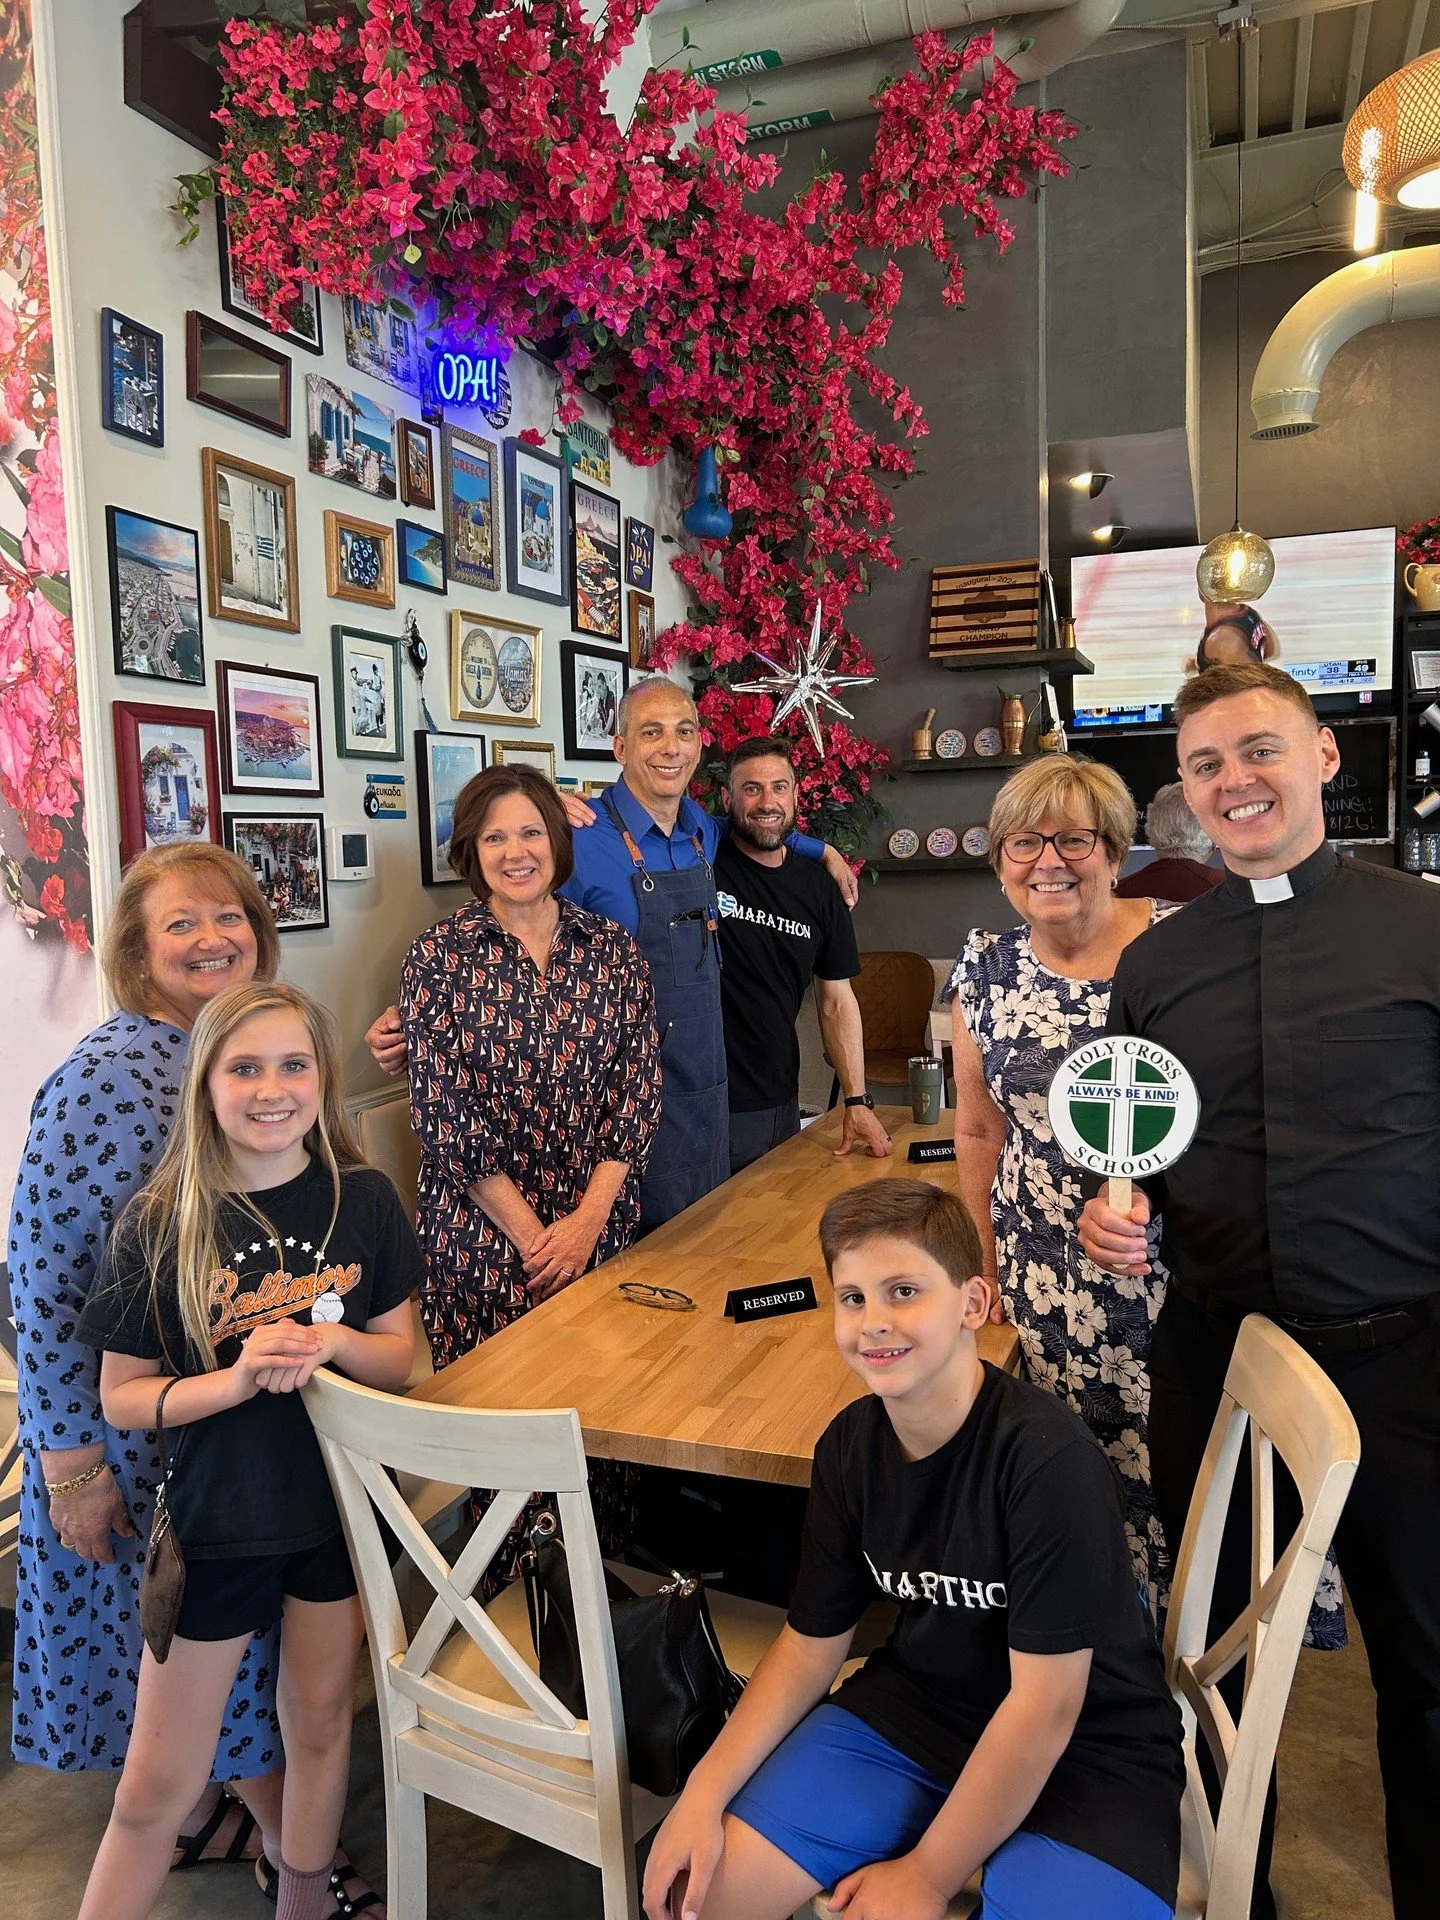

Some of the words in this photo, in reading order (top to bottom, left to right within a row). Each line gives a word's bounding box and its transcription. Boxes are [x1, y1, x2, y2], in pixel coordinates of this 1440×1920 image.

[708, 55, 768, 82] STORM
[438, 352, 497, 404] OPA!
[567, 421, 609, 458] SANTORINI
[452, 457, 487, 480] GREECE
[577, 494, 616, 521] GREECE
[955, 575, 991, 590] Inaugural
[997, 575, 1018, 586] 2024
[959, 632, 1009, 642] CHAMPION
[504, 664, 530, 689] Yamas!
[1326, 666, 1340, 674] 38
[1354, 664, 1370, 672] 49
[731, 904, 811, 940] MARATHON
[1067, 1041, 1117, 1076] HOLY
[1123, 1041, 1183, 1080] CROSS
[1066, 1085, 1122, 1099] ALWAYS
[1125, 1088, 1141, 1099] BE
[1144, 1090, 1180, 1102] KIND!
[920, 1146, 957, 1158] RESERV
[1073, 1145, 1168, 1175] SCHOOL
[207, 1262, 363, 1332] Baltimore
[743, 1290, 805, 1311] RESERVED
